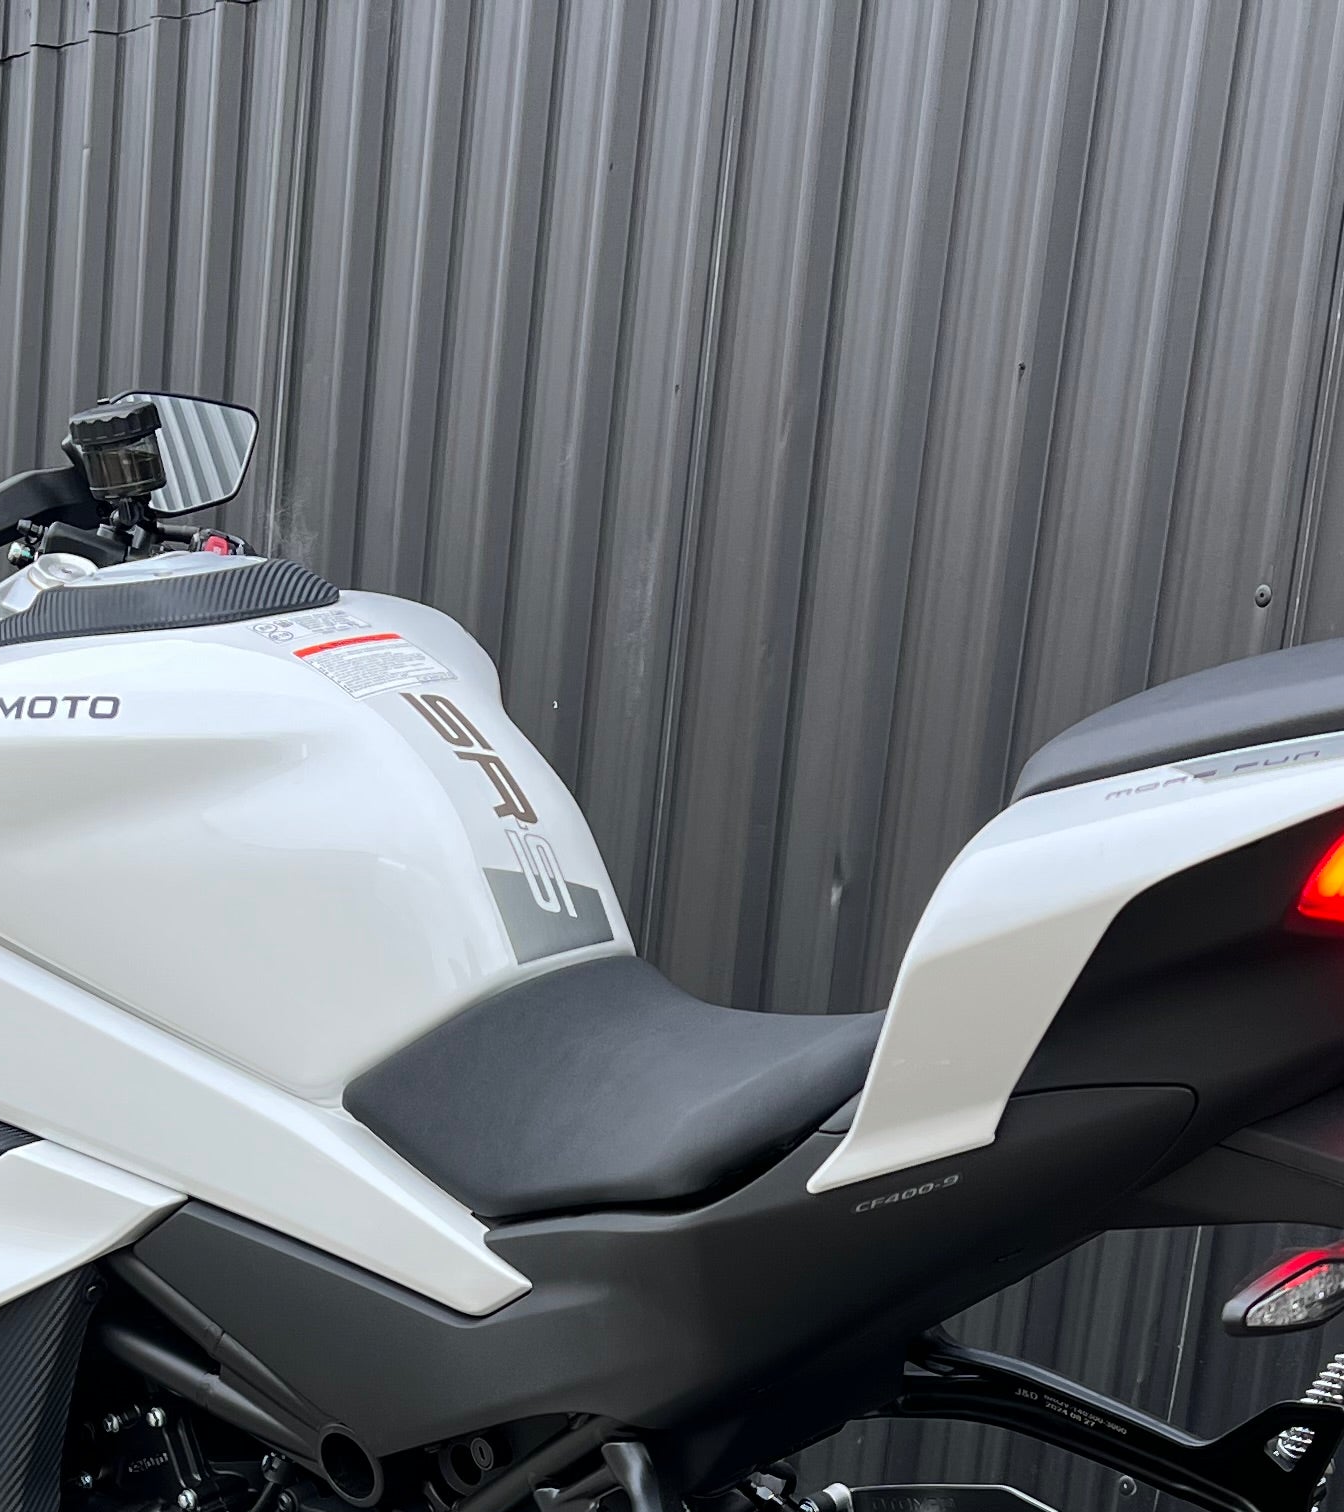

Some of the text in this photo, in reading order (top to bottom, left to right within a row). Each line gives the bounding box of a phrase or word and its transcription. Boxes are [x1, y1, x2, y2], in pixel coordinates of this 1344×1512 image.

[1104, 749, 1322, 801] MORE FUN
[855, 1174, 959, 1213] CF400-9
